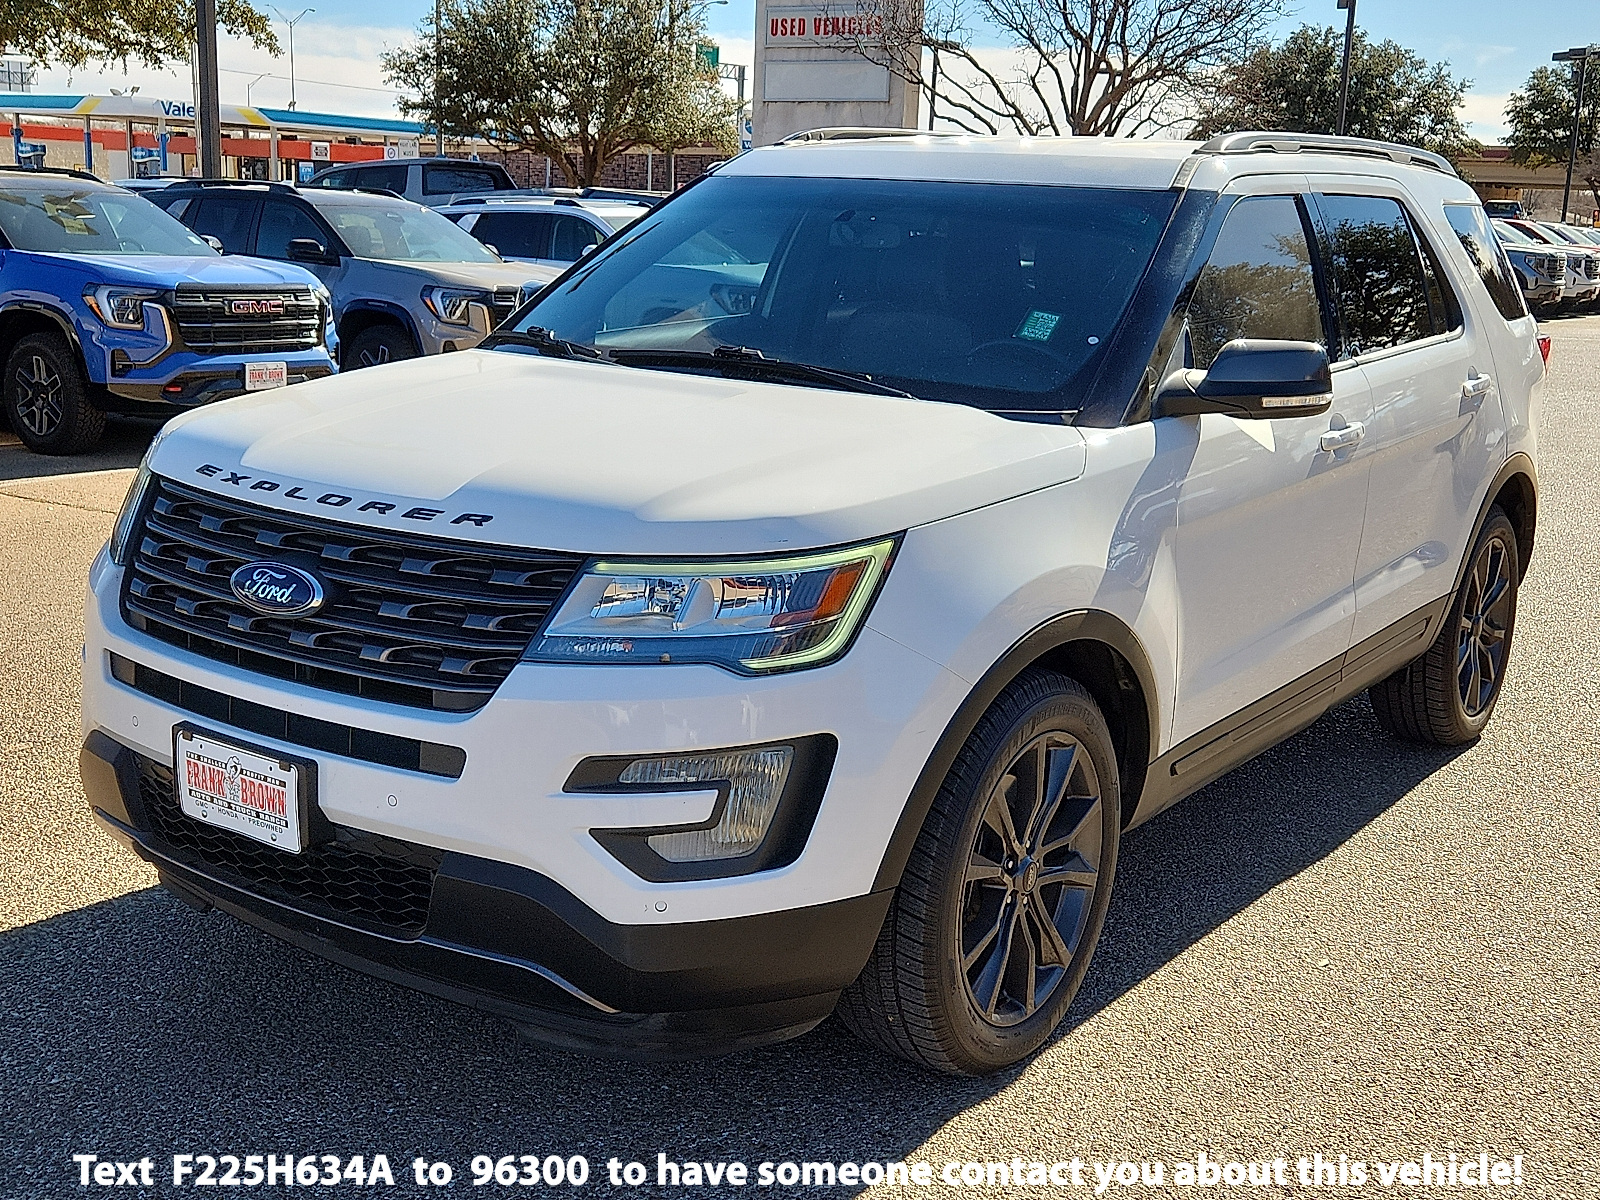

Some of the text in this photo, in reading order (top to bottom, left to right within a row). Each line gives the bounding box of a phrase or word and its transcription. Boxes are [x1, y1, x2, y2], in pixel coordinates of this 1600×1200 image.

[770, 17, 806, 37] USED
[160, 100, 195, 118] Vale
[231, 300, 284, 314] GMC
[195, 463, 494, 527] EXPLORER
[244, 568, 297, 604] Ford
[186, 759, 287, 818] FRANK BROWN
[191, 790, 286, 827] AUTO AND TRUCK RANCH
[194, 799, 284, 834] GMC HONDA PREOWNED
